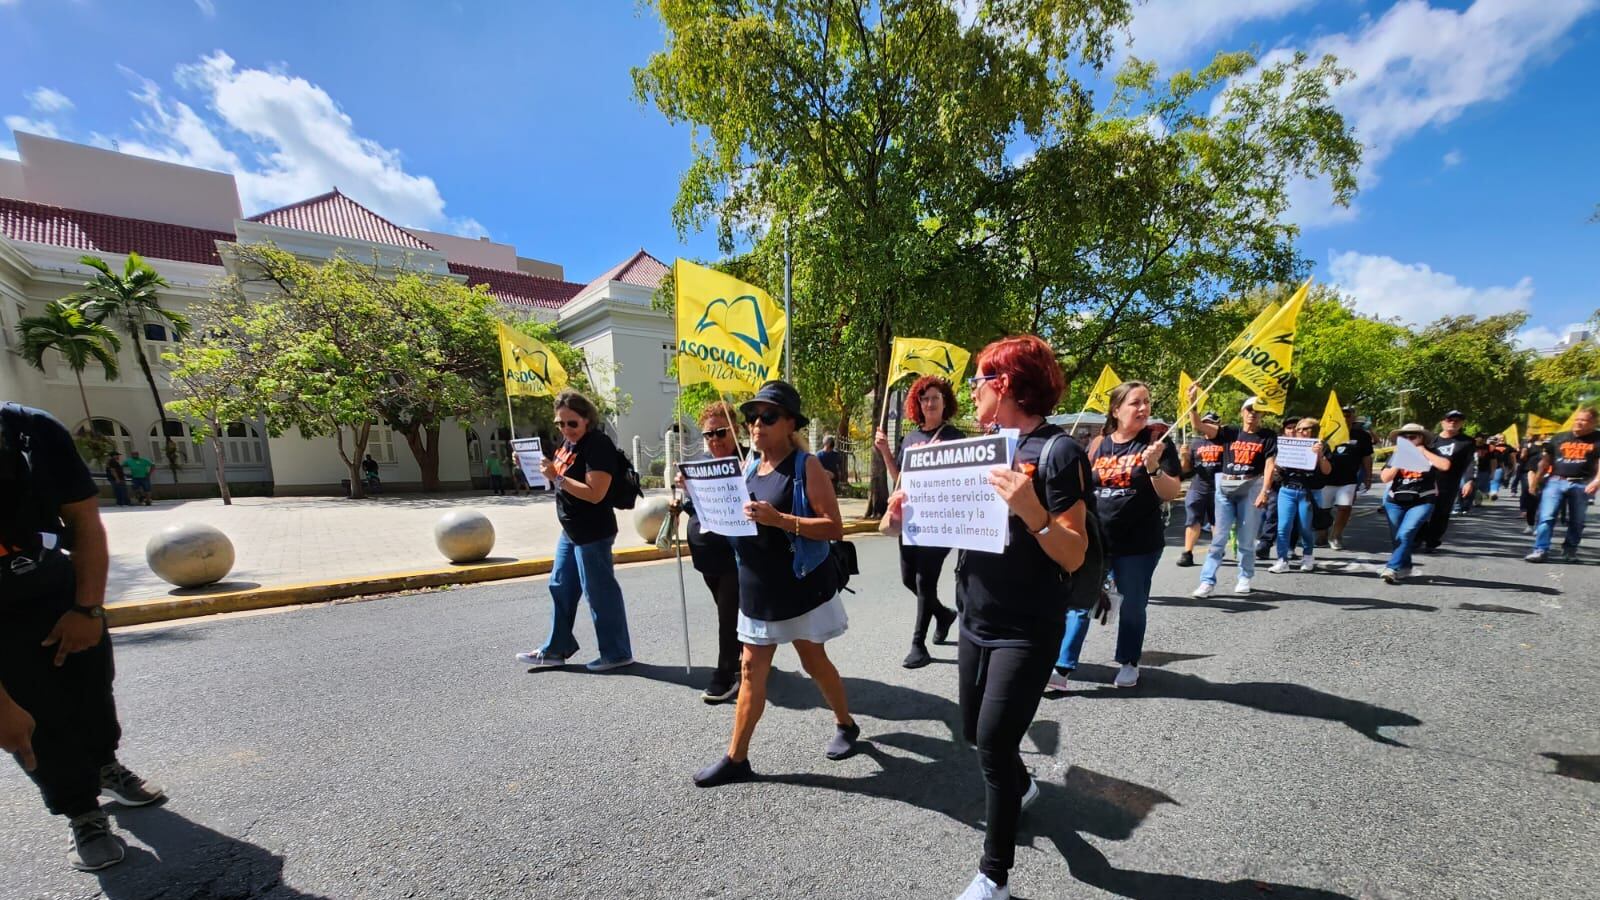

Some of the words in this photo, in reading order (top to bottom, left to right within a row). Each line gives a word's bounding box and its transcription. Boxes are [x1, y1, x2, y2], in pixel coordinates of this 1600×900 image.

[910, 443, 996, 468] RECLAMAMOS
[910, 479, 921, 489] No
[923, 478, 962, 488] aumento
[964, 478, 976, 487] en
[910, 492, 936, 503] tarifas
[938, 491, 949, 502] de
[951, 490, 996, 502] servicios
[920, 507, 966, 519] esenciales
[968, 510, 974, 522] y
[977, 508, 985, 519] la
[941, 523, 953, 534] de
[955, 524, 999, 538] alimentos
